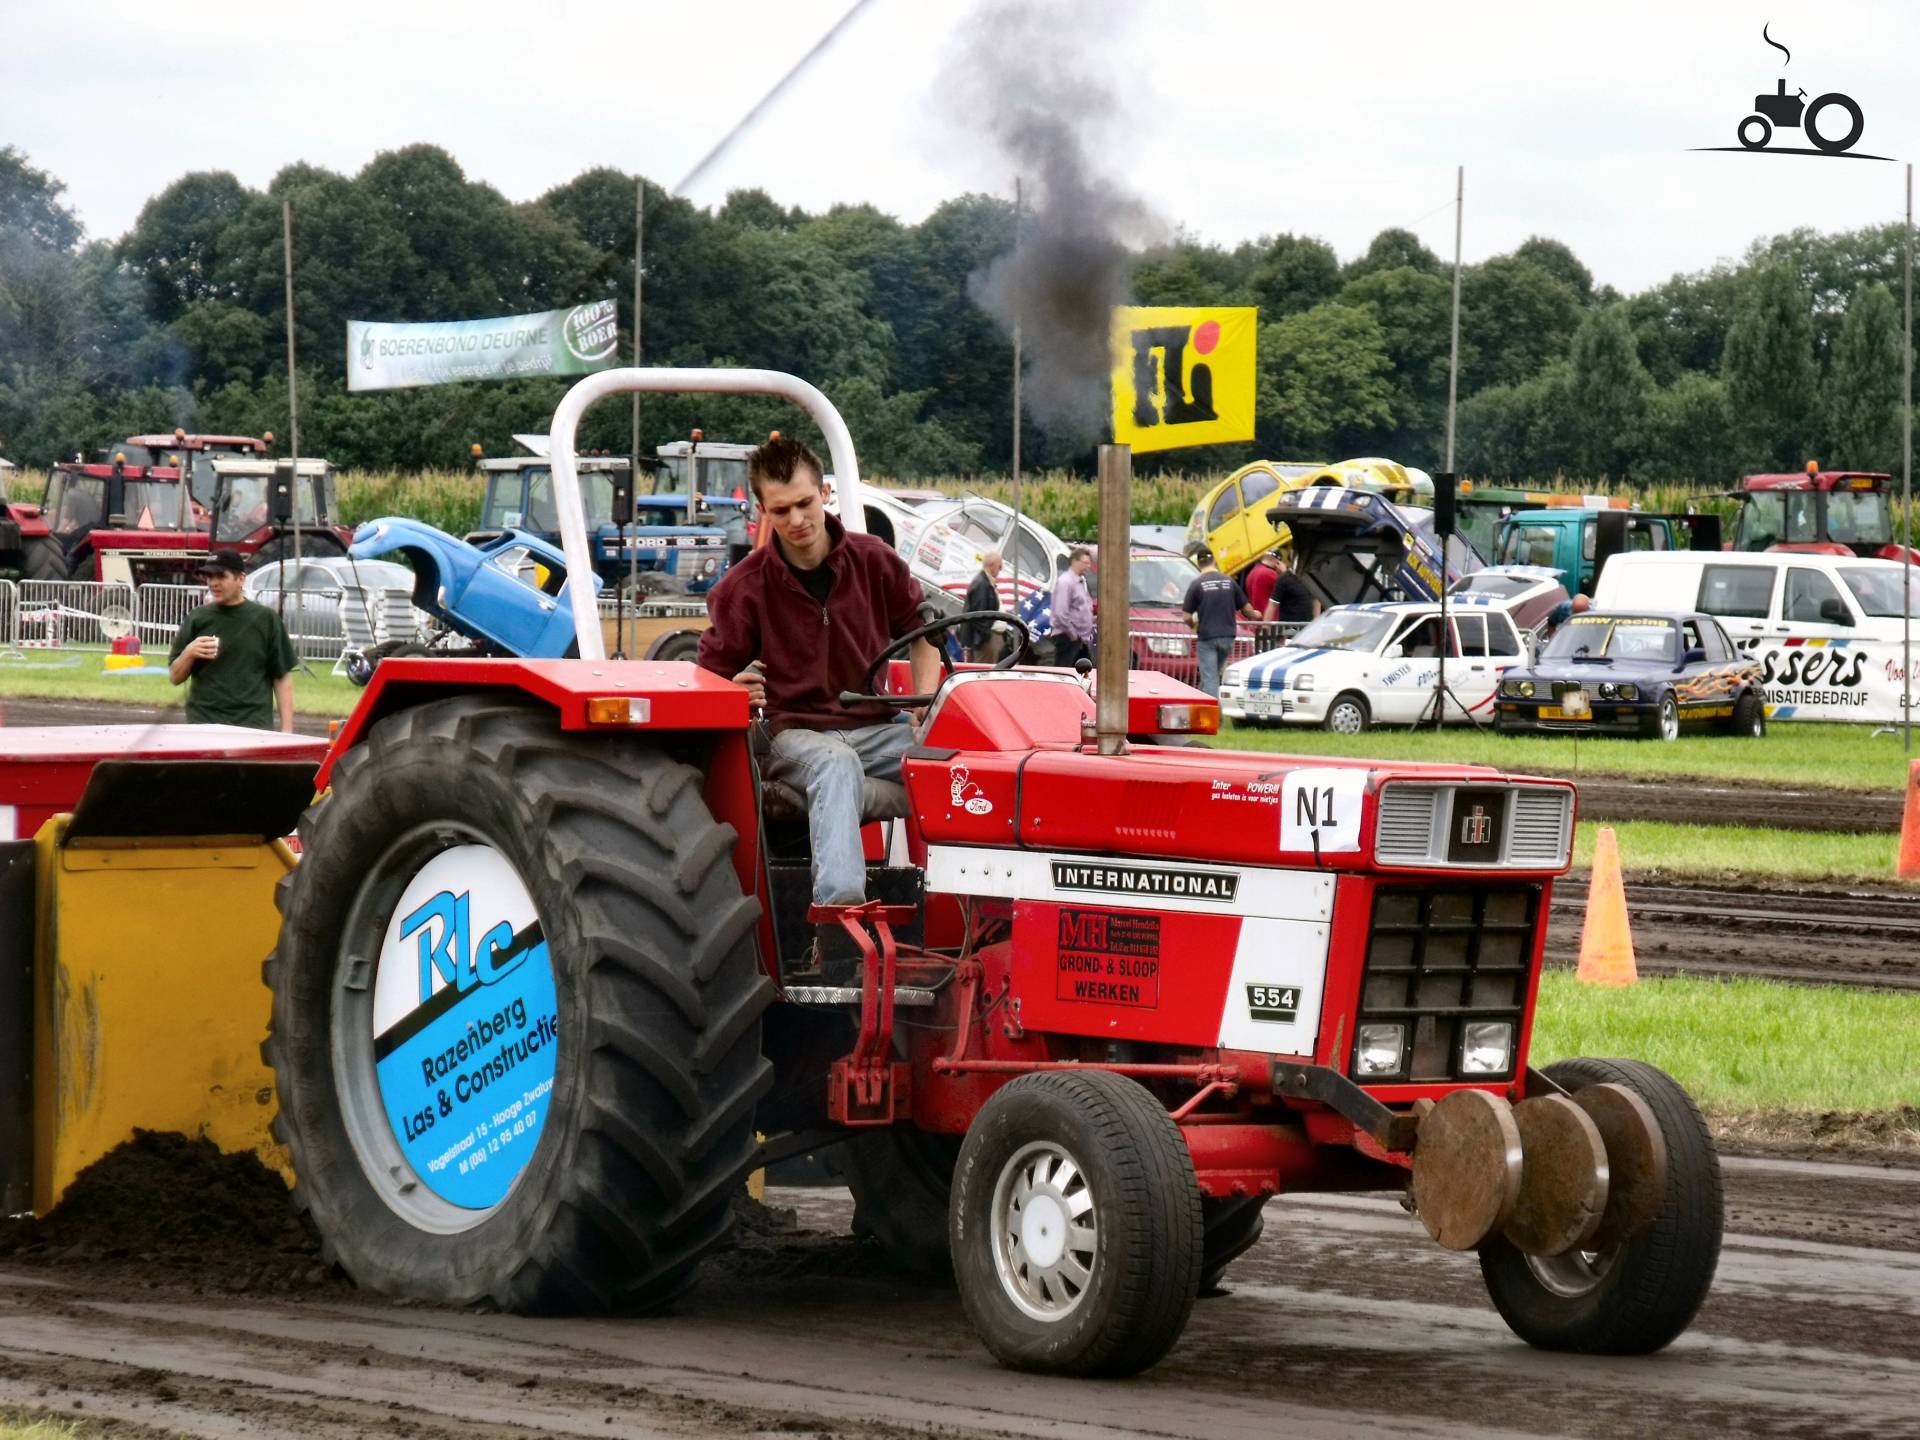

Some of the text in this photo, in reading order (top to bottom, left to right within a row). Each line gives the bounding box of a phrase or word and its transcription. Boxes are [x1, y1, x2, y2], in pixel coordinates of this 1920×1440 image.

[379, 327, 548, 357] BOERENBOND DEURNE
[1570, 617, 1668, 627] BMW racing
[1212, 779, 1231, 790] Inter
[1297, 786, 1337, 827] N1
[1057, 867, 1232, 897] INTERNATIONAL
[1061, 911, 1110, 949] MH
[1060, 954, 1156, 978] GROND- & SLOOP
[1075, 980, 1139, 1002] WERKEN
[1253, 987, 1294, 1008] 554
[421, 997, 527, 1088] Razenberg
[402, 1014, 557, 1144] Las & Constructie
[476, 1123, 489, 1139] 15
[492, 1100, 522, 1128] Hooge
[459, 1161, 469, 1176] M
[468, 1147, 488, 1171] (06)
[488, 1138, 500, 1155] 12
[500, 1129, 512, 1146] 95
[513, 1121, 525, 1137] 40
